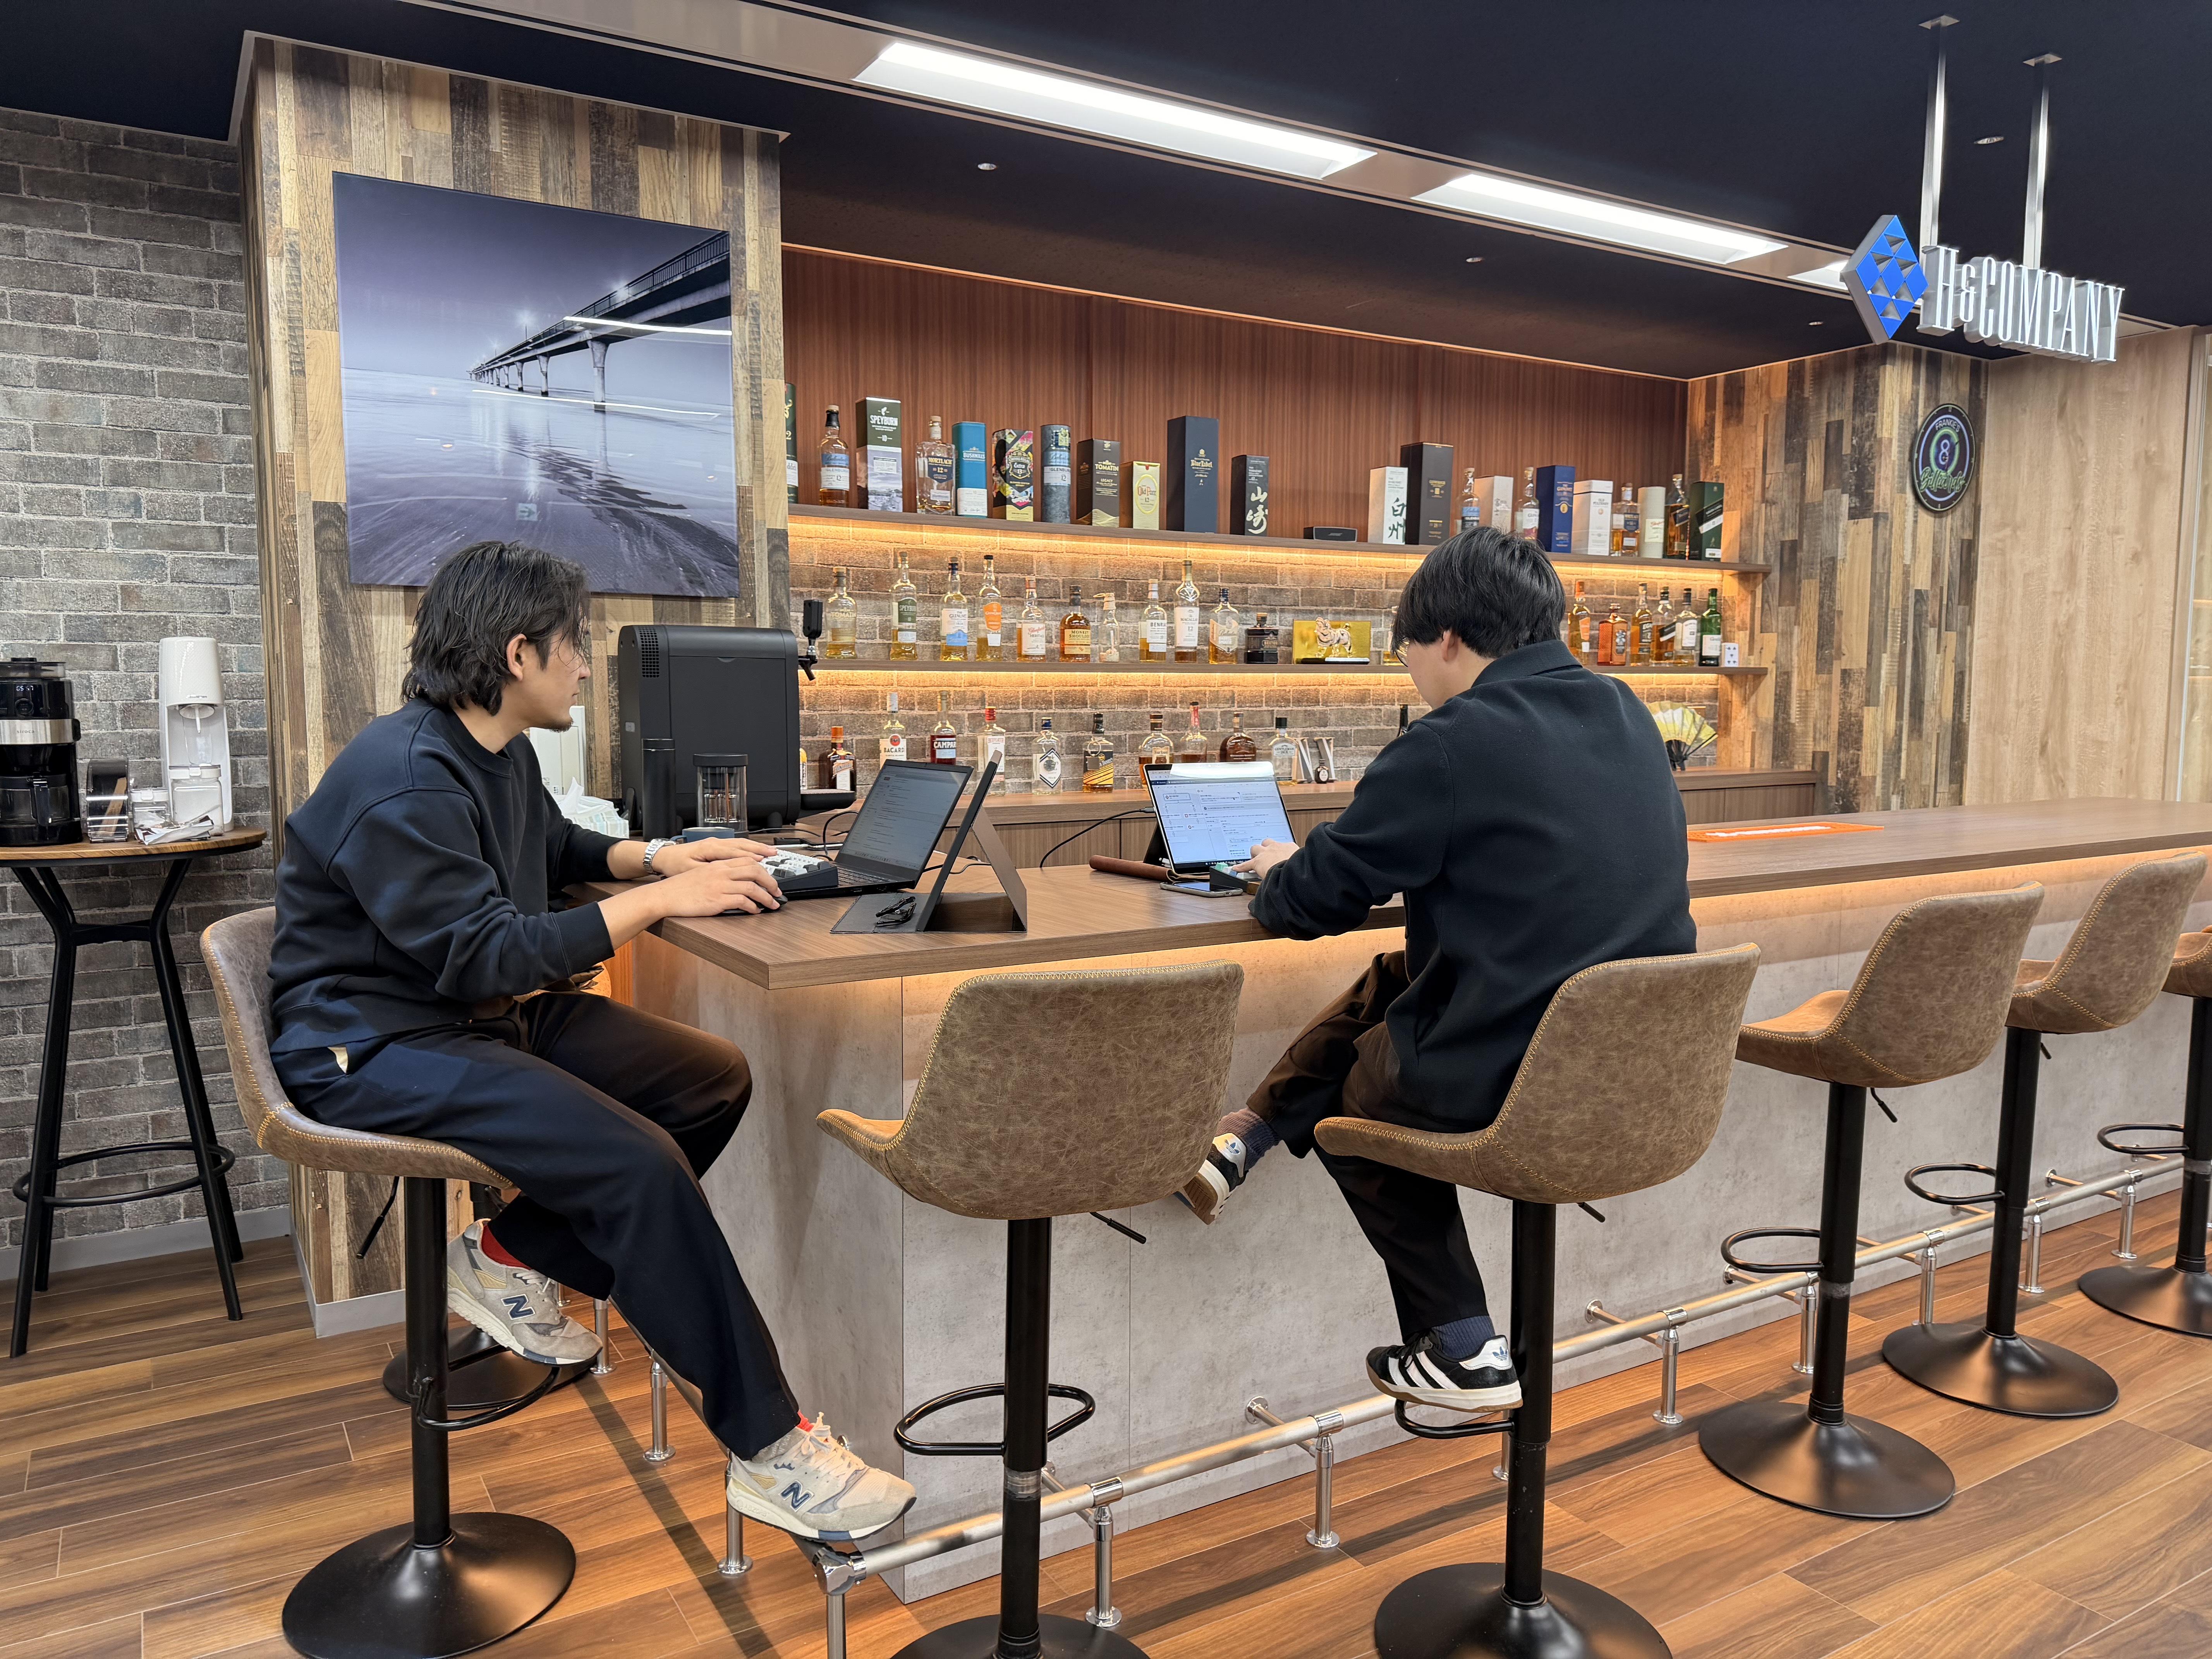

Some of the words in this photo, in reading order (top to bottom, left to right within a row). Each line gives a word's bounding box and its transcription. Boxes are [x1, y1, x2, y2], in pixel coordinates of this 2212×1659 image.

[1918, 245, 2125, 362] H&COMPANY
[870, 415, 898, 426] SPEYBURN
[1936, 419, 1961, 433] FRANKIE'S
[928, 457, 953, 465] MORTLACH
[1939, 439, 1950, 465] 8
[1920, 466, 1966, 493] Billiards
[1388, 497, 1407, 543] 白州
[501, 1293, 536, 1320] N
[778, 1480, 814, 1512] N
